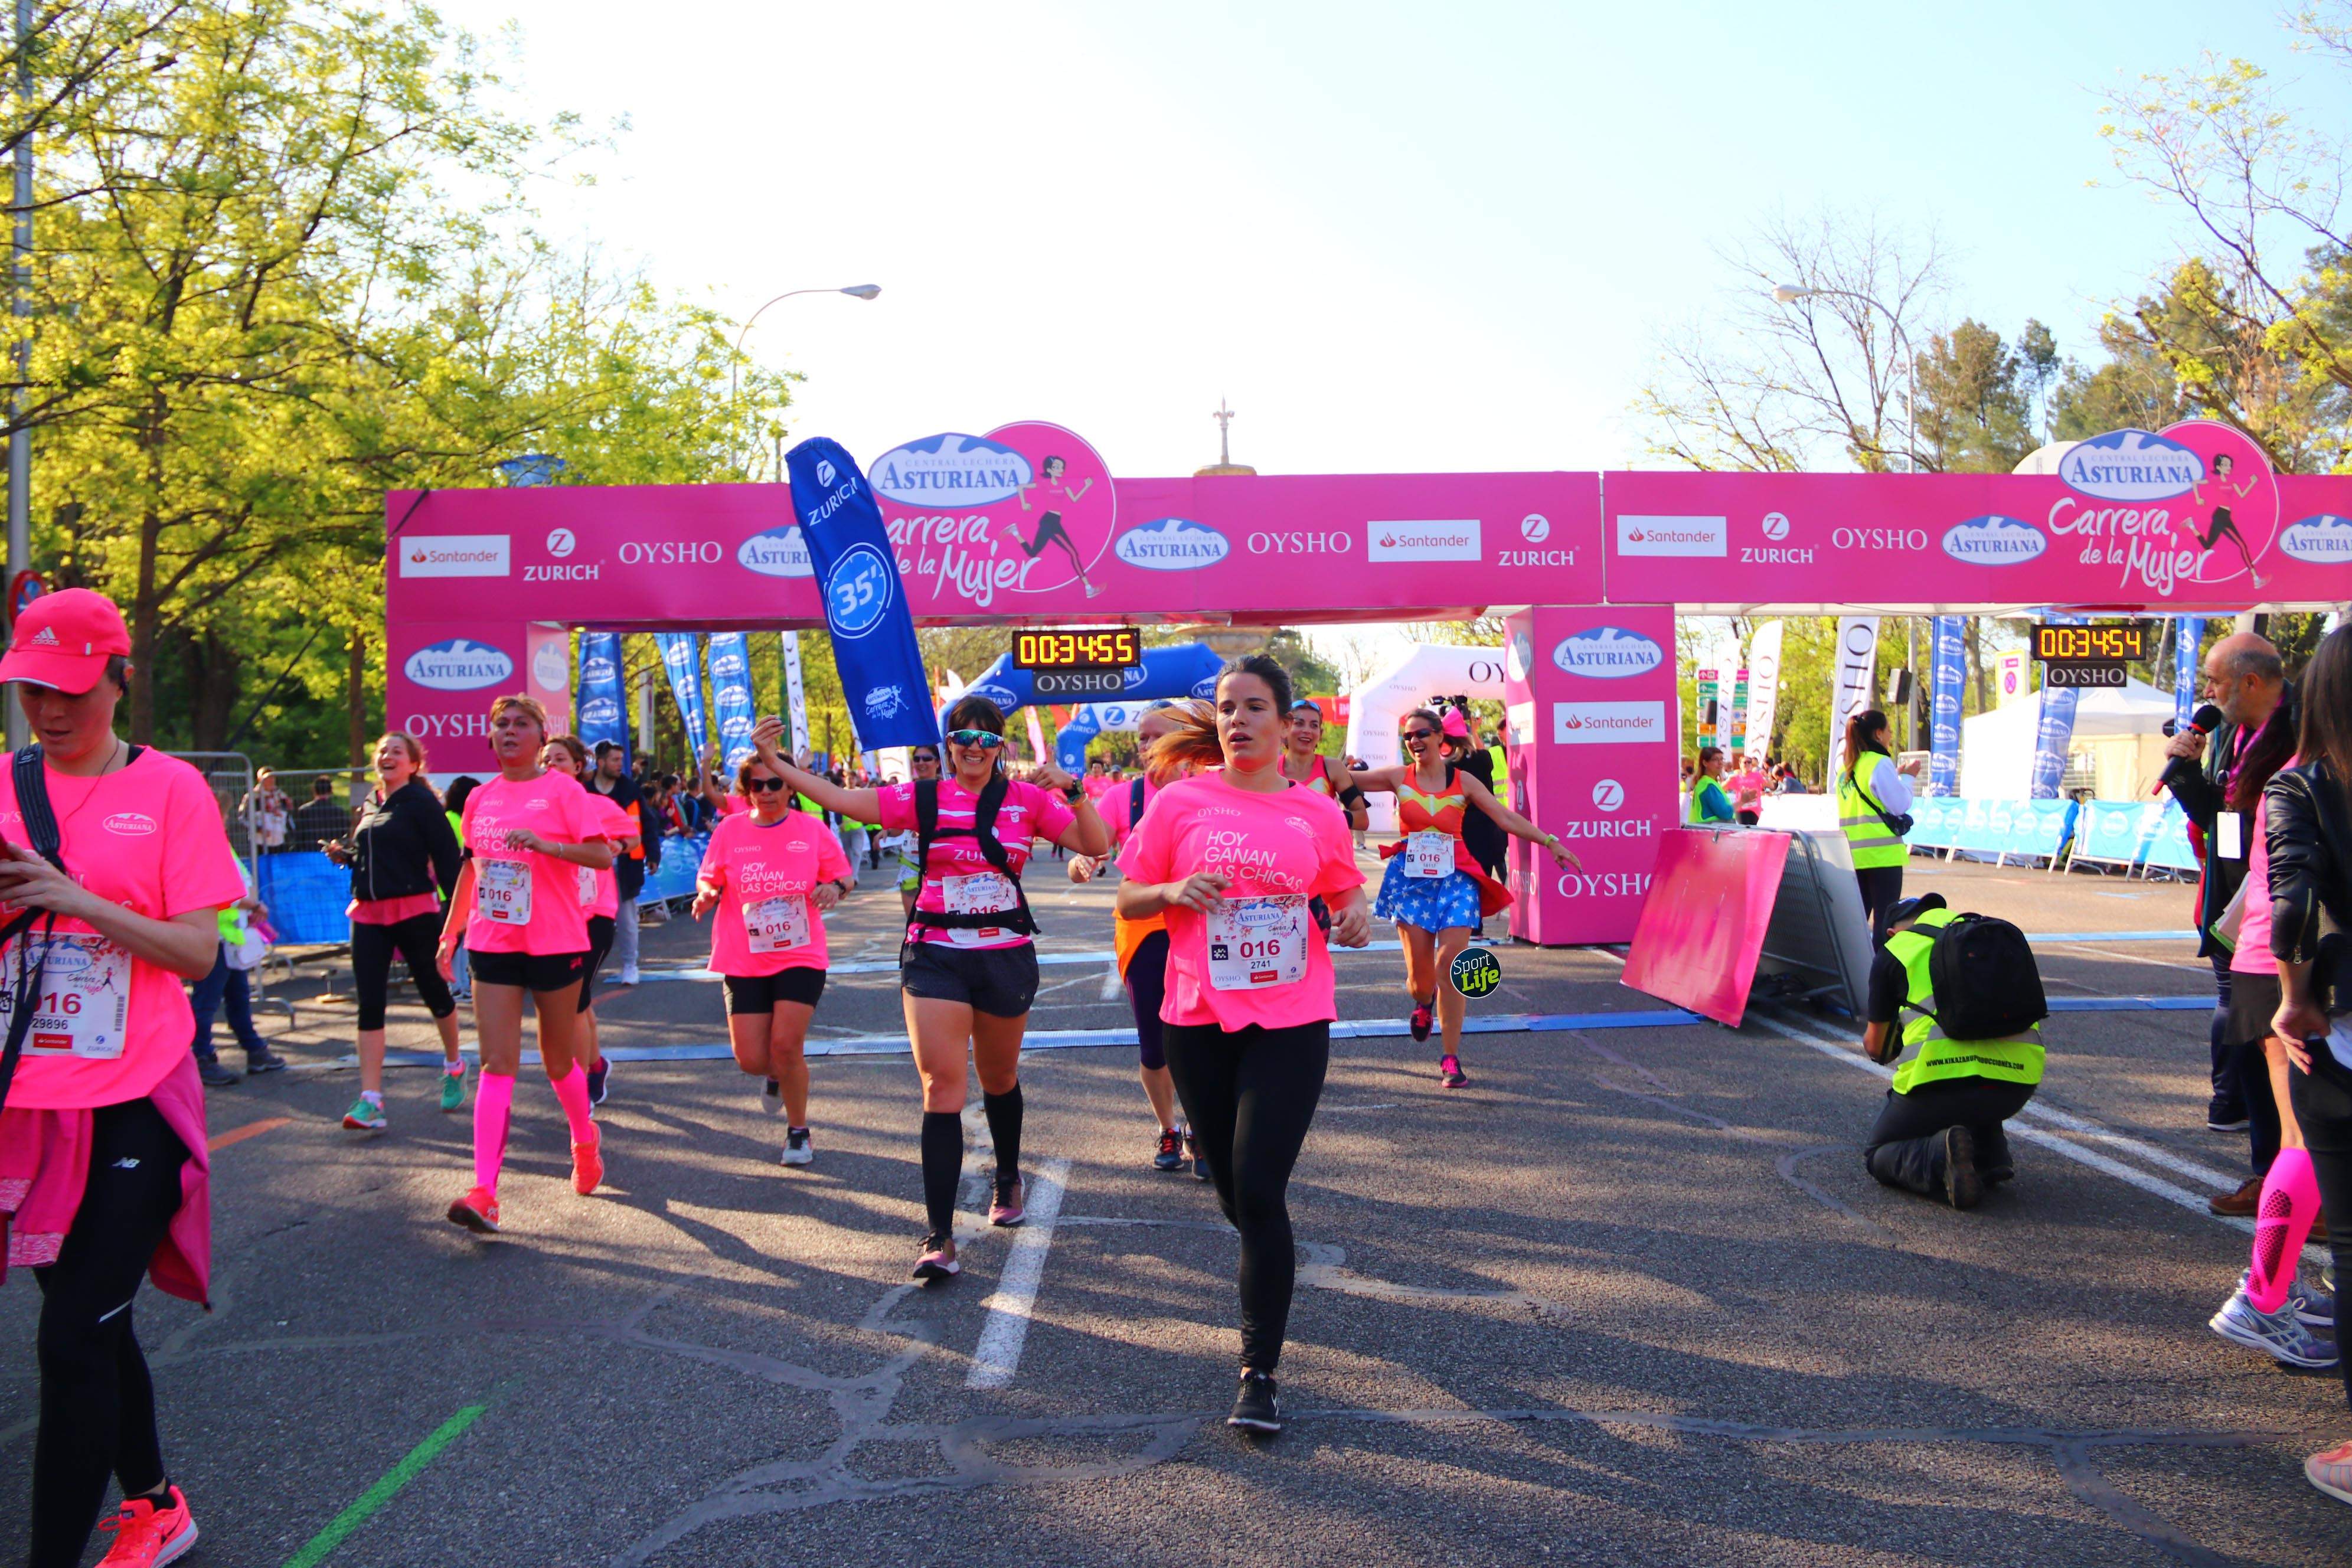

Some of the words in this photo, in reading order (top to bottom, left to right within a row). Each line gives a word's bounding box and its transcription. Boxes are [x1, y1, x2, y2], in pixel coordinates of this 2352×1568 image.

[905, 459, 957, 467] CENTRAL
[963, 458, 1015, 466] LECHERA
[2071, 456, 2194, 483] ASTURIANA
[880, 462, 1020, 490] ASTURIANA
[2049, 497, 2170, 535] Carrera
[1247, 531, 1352, 554] OYSHO
[1399, 535, 1469, 547] Santander
[1647, 530, 1716, 542] Santander
[1832, 528, 1928, 550] OYSHO
[1950, 534, 2039, 553] ASTURIANA
[2286, 533, 2352, 551] ASTURIA
[619, 541, 722, 564] OYSHO
[746, 545, 812, 564] ASTURI
[1123, 538, 1221, 557] ASTURIANA
[1741, 548, 1812, 563] ZURICH
[429, 551, 498, 563] Santander
[1498, 550, 1574, 566] ZURICH
[2079, 537, 2102, 564] de
[2107, 537, 2124, 564] la
[2120, 533, 2214, 596] Mujer
[523, 564, 599, 581] ZURICH
[918, 547, 935, 574] la
[932, 540, 1041, 606] Mujer
[1020, 634, 1132, 664] 00:34:55
[2040, 629, 2141, 657] 00:34:54
[1562, 646, 1655, 665] ASTURIANA
[413, 659, 505, 677] ASTURIANA
[1469, 661, 1505, 682] OY
[2050, 668, 2124, 684] OYSHO
[1037, 674, 1121, 691] OYSHO
[1389, 684, 1416, 692] OYSHO
[405, 714, 492, 737] OYSH
[1067, 724, 1096, 733] ZURICH
[1585, 717, 1653, 729] Santander
[1198, 806, 1241, 818] OYSHO
[108, 818, 152, 831] ASTURIANA
[1567, 820, 1651, 838] ZURICH
[1206, 831, 1249, 846] HOY
[1204, 847, 1276, 868] GANAN
[1420, 854, 1440, 862] 016
[742, 862, 766, 873] HOY
[741, 871, 784, 883] GANAN
[1240, 866, 1303, 891] CHICAS
[489, 888, 512, 901] 016
[741, 883, 761, 893] LAS
[763, 881, 807, 892] CHICAS
[967, 884, 998, 893] ASTURIANA
[1238, 912, 1280, 922] ASTURIANA
[766, 921, 790, 934] 016
[1240, 939, 1280, 958] 016
[1251, 961, 1270, 969] 2741
